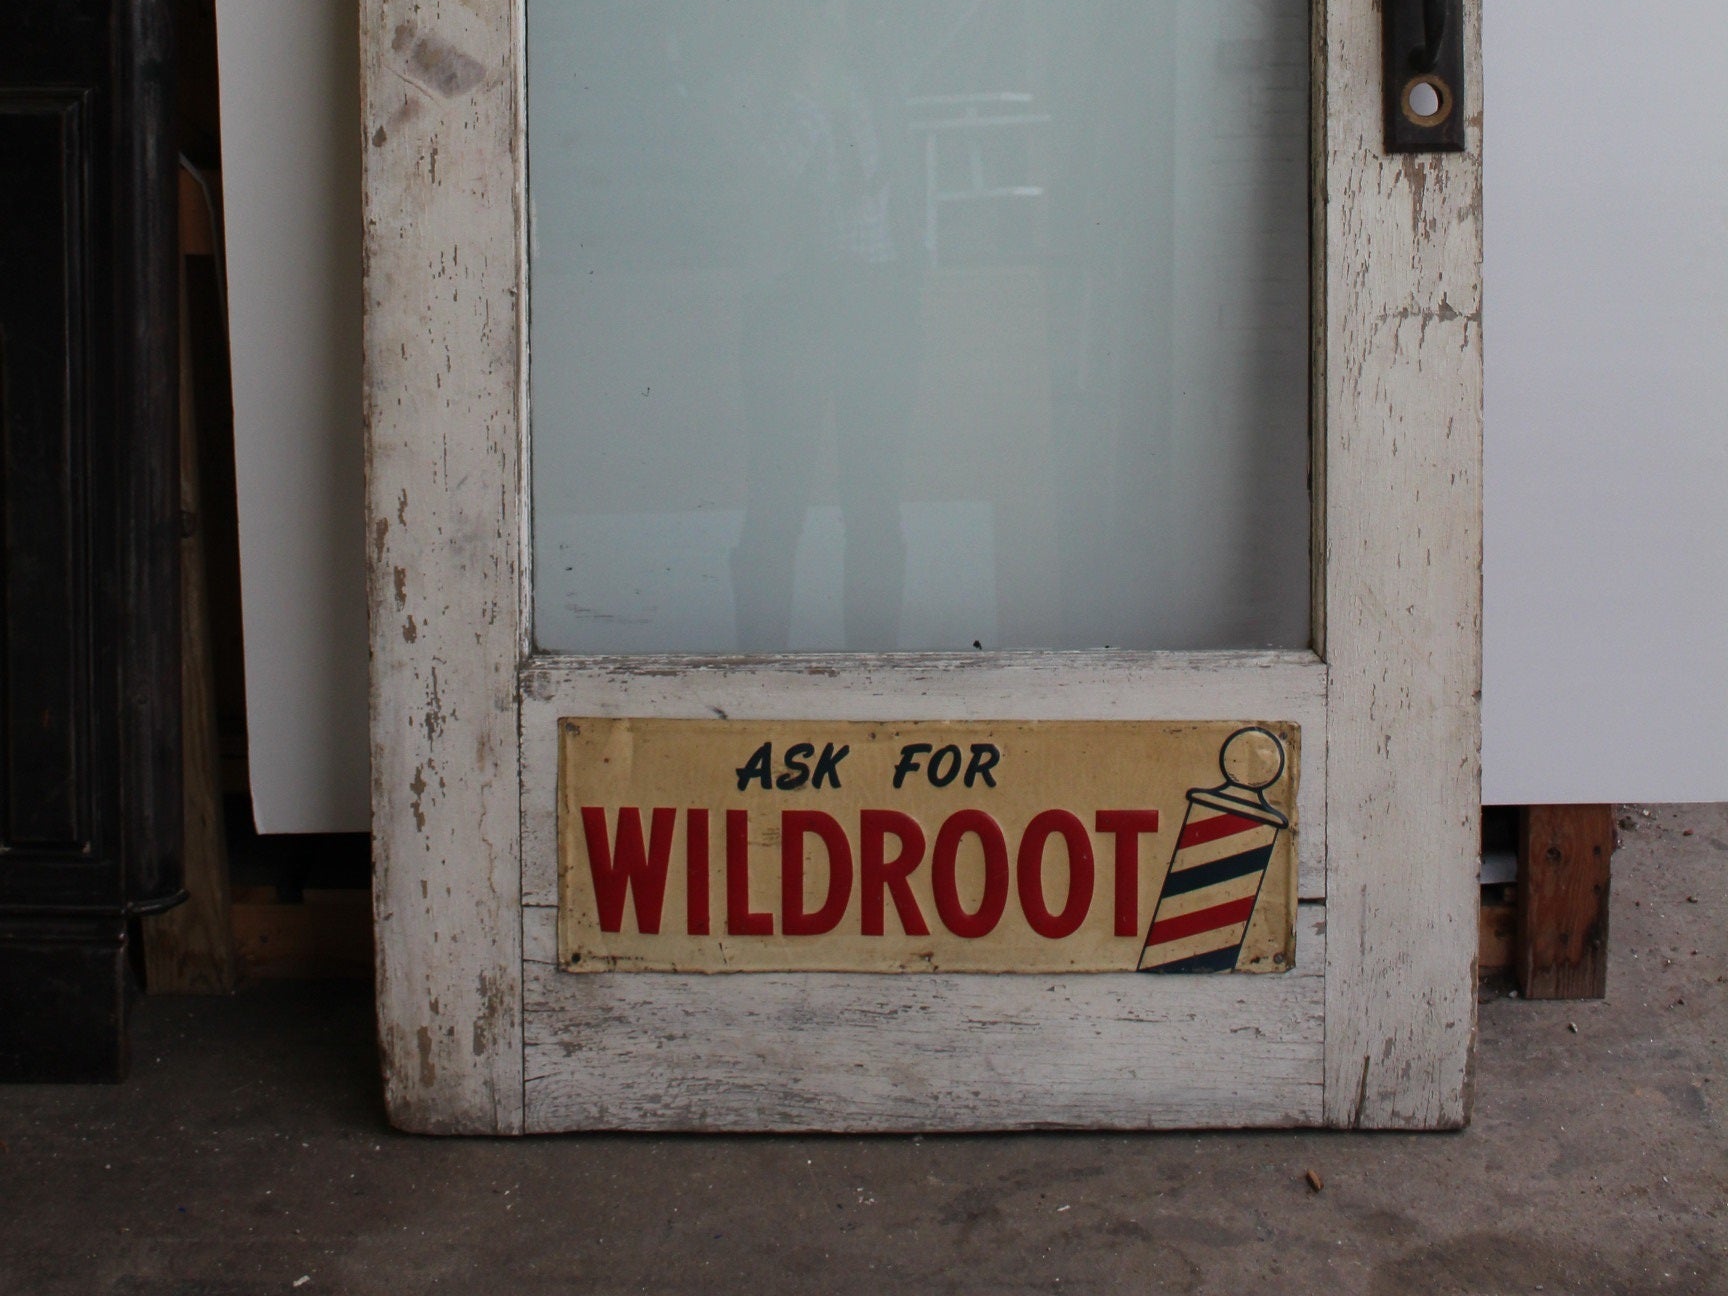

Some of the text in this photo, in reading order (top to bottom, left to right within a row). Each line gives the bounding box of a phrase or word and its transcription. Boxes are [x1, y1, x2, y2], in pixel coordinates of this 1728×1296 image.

[735, 742, 1001, 791] ASK FOR
[580, 806, 1160, 939] WILDROOT
